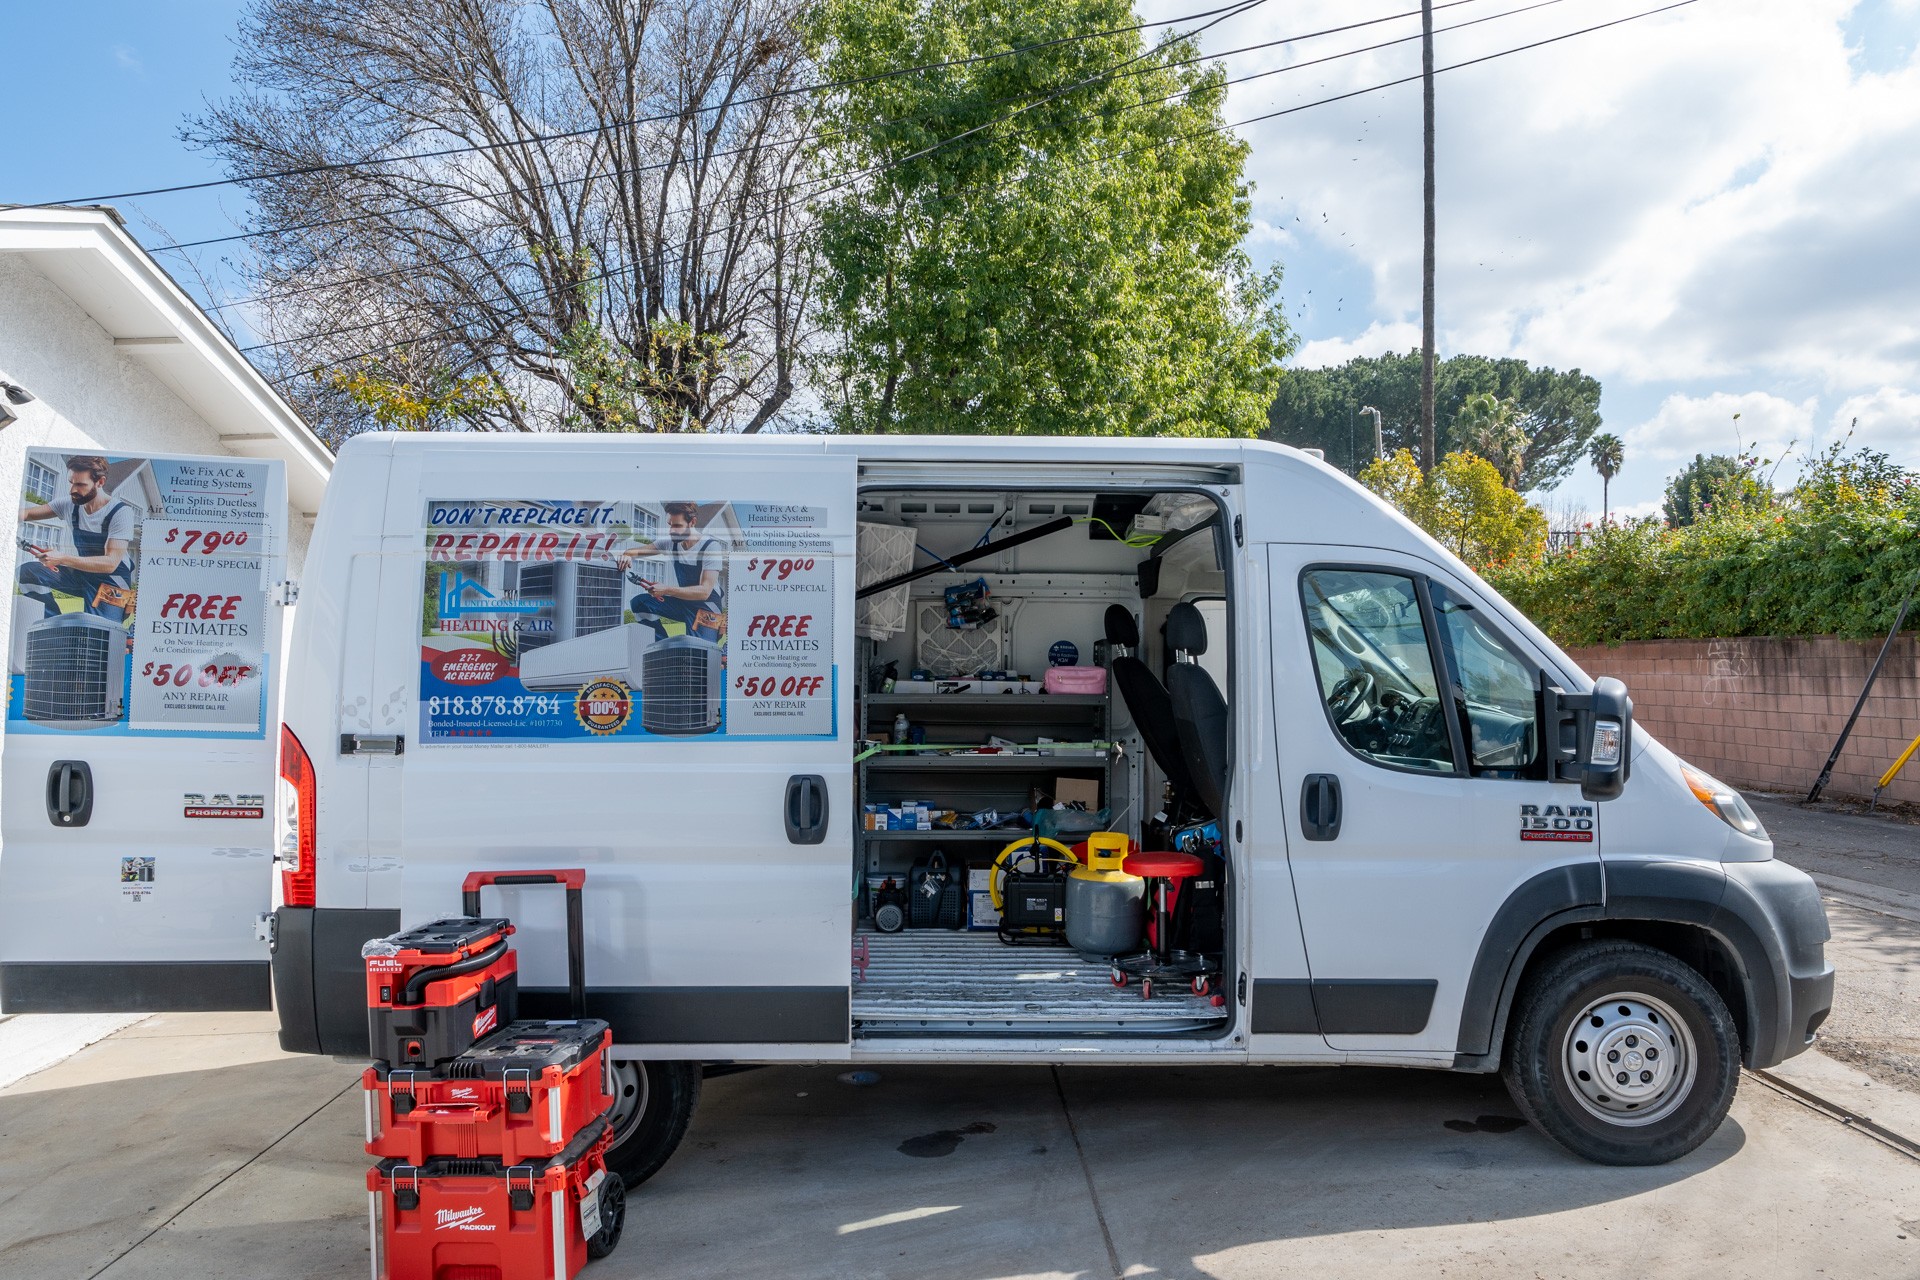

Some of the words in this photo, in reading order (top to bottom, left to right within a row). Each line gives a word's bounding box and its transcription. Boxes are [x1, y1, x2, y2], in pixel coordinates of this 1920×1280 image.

[180, 466, 195, 475] We
[198, 468, 214, 476] Fix
[217, 469, 233, 477] AC
[236, 470, 245, 478] &
[170, 477, 209, 488] Heating
[212, 479, 252, 489] Systems
[162, 495, 184, 504] Mini
[187, 496, 214, 506] Splits
[217, 498, 257, 507] Ductless
[147, 505, 163, 513] Air
[166, 506, 227, 518] Conditioning
[231, 509, 269, 519] Systems
[755, 505, 766, 513] We
[770, 505, 782, 513] Fix
[431, 508, 496, 524] DON'T
[498, 508, 588, 524] REPLACE
[590, 508, 627, 524] IT...
[748, 514, 779, 523] Heating
[782, 514, 815, 523] Systems
[763, 531, 785, 539] Splits
[430, 532, 559, 562] REPAIR
[565, 532, 618, 562] IT!
[746, 539, 796, 548] Conditioning
[799, 540, 831, 548] Systems
[148, 558, 164, 566] AC
[167, 558, 215, 568] TUNE-UP
[217, 560, 261, 570] SPECIAL
[734, 584, 748, 592] AC
[749, 584, 788, 592] TUNE-UP
[790, 584, 827, 592] SPECIAL
[161, 593, 242, 620] FREE
[151, 621, 248, 636] ESTIMATES
[440, 620, 508, 632] HEATING
[513, 620, 524, 632] &
[528, 620, 554, 632] AIR
[747, 615, 812, 637] FREE
[741, 639, 819, 651] ESTIMATES
[443, 663, 498, 672] EMERGENCY
[142, 661, 193, 687] $50
[198, 665, 251, 688] OFF
[445, 672, 457, 680] AC
[458, 672, 494, 680] REPAIR!
[586, 683, 621, 694] SATISFACTION
[735, 675, 776, 697] $50
[780, 675, 824, 697] OFF
[190, 693, 229, 702] REPAIR
[428, 694, 560, 717] 818.878.8784
[588, 701, 619, 715] 100%
[774, 701, 806, 709] REPAIR
[587, 720, 620, 729] GUARANTEED
[184, 793, 264, 806] RAM
[1520, 804, 1593, 817] RAM
[1520, 817, 1593, 830] 1500
[434, 1206, 483, 1225] Milwaukee
